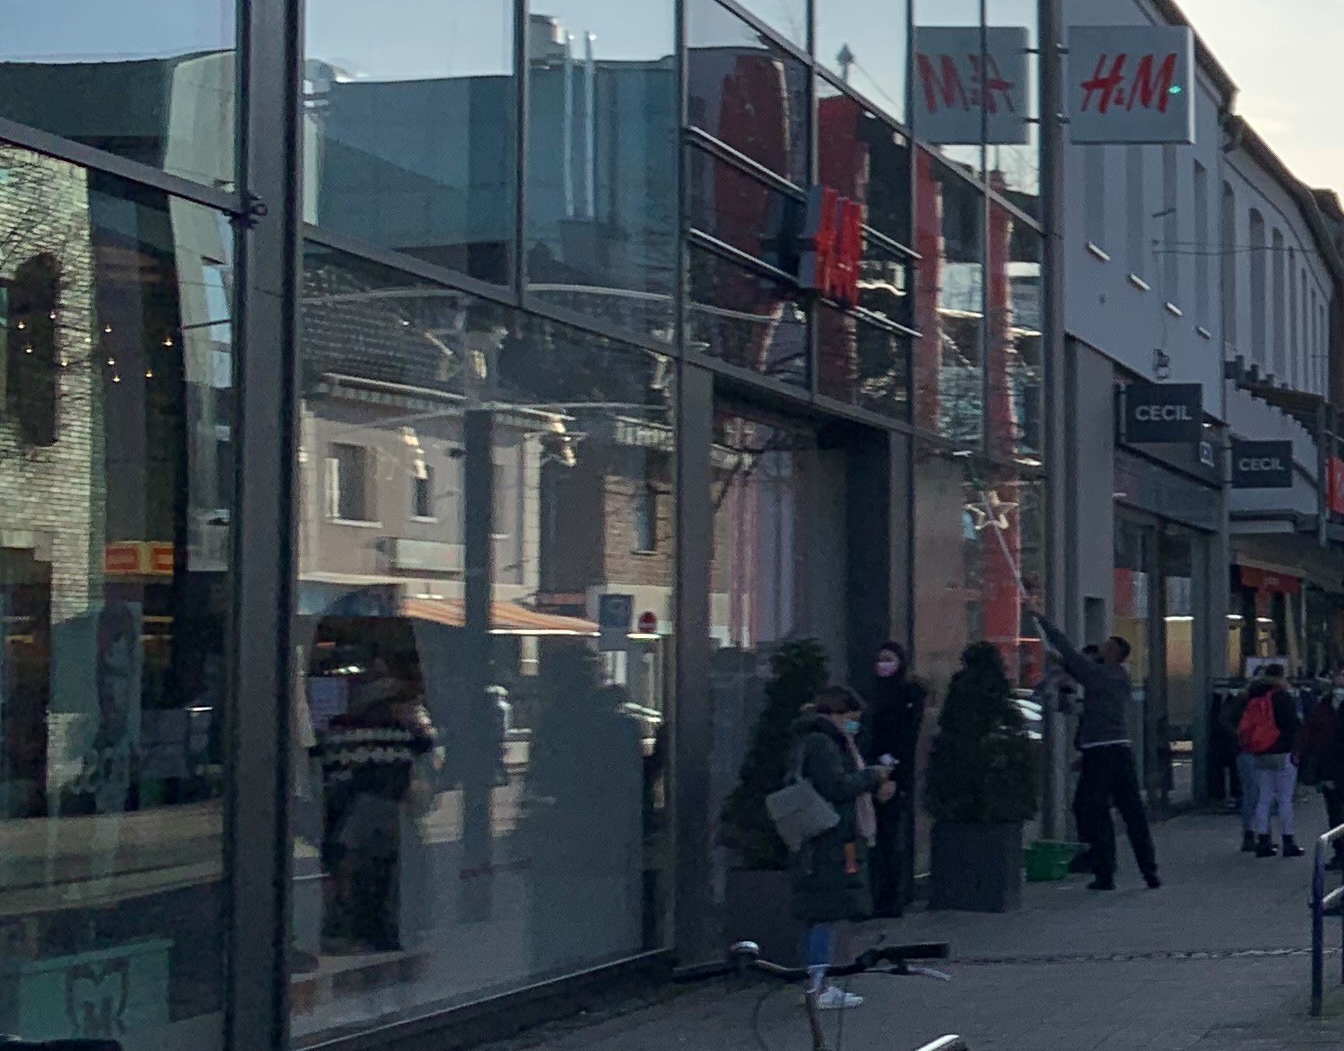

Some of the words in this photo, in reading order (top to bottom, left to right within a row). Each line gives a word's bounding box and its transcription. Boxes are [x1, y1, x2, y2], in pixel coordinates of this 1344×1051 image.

[1081, 52, 1177, 114] H&M
[1134, 404, 1193, 421] CECIL
[1238, 457, 1286, 471] CECIL
